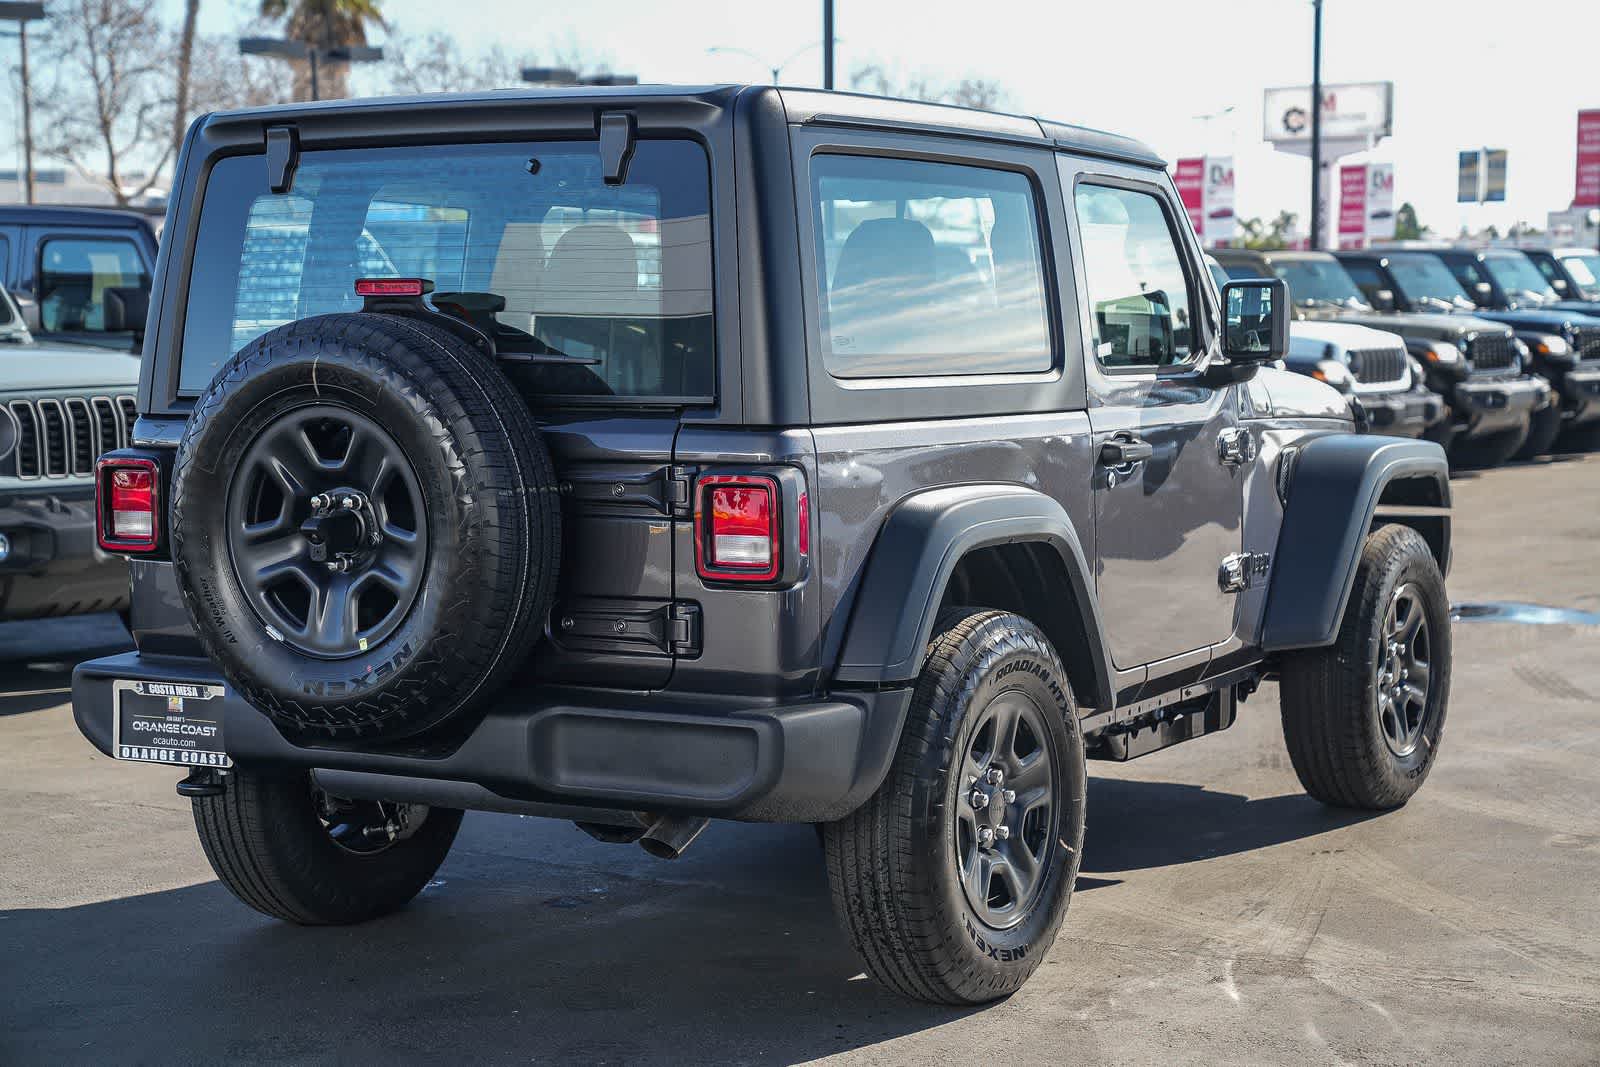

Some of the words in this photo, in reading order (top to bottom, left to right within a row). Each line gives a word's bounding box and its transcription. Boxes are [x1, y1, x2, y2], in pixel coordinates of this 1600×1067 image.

[994, 659, 1051, 685] ROADIAN
[148, 683, 175, 696] COSTA
[175, 685, 199, 697] MESA
[132, 720, 180, 734] ORANGE
[180, 724, 217, 737] COAST
[152, 736, 196, 748] ocauto.com
[122, 746, 176, 761] ORANGE
[181, 751, 225, 766] COAST
[966, 919, 1026, 963] NEXEN
